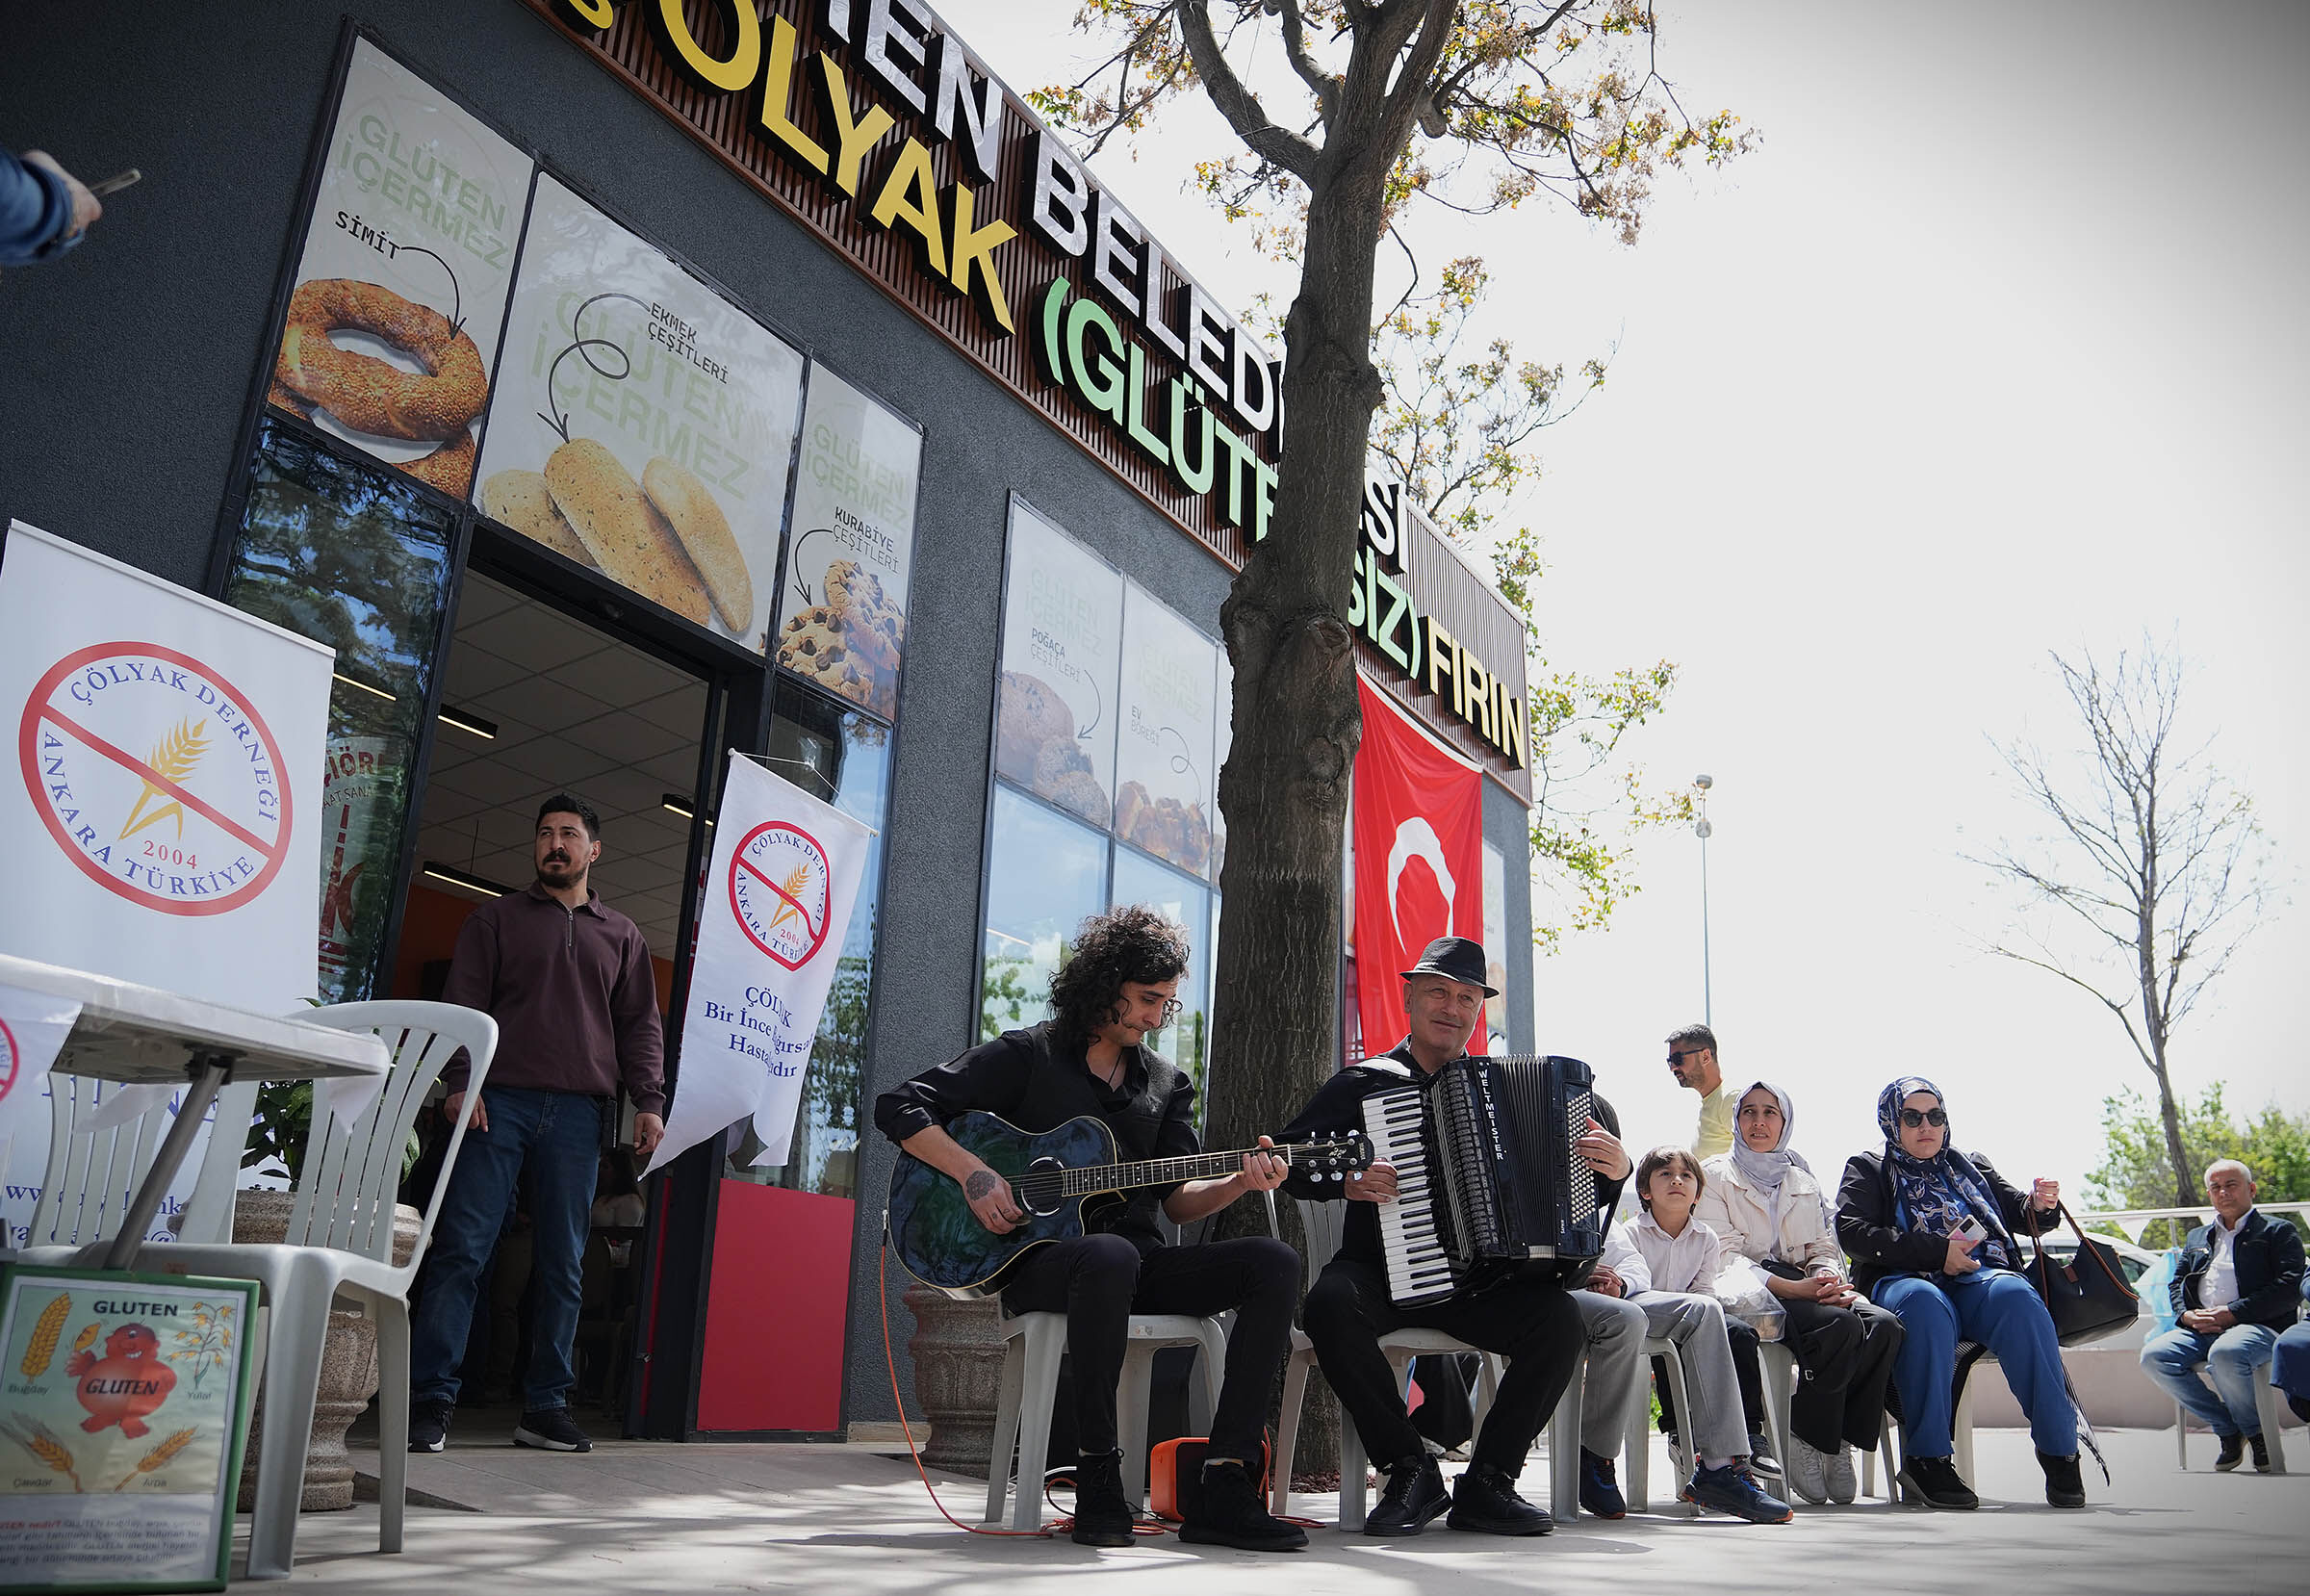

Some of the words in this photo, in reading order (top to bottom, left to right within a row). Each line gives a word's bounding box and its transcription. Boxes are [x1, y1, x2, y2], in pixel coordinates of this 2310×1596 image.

[829, 0, 1003, 183] EN
[359, 115, 506, 232] GLÜTEN
[340, 134, 509, 270] İÇERMEZ
[335, 211, 400, 260] SİMİT
[650, 302, 698, 345] EKMEK
[648, 322, 730, 384] ÇEŞİTLERİ
[834, 506, 894, 553] KURABİYE
[834, 524, 899, 575] ÇEŞİTLERİ
[1032, 627, 1065, 660] POĞAÇA
[1427, 613, 1526, 770] FIRIN
[70, 662, 188, 707] ÇÖLYAK
[195, 684, 279, 822] DERNEĞİ
[44, 732, 114, 865] ANKARA
[124, 856, 255, 896] TÜRKİYE
[143, 839, 198, 870] 2004
[752, 833, 801, 857] ÇÖLYAK
[737, 871, 767, 941] ANKARA
[705, 1000, 734, 1023] Bir
[739, 1007, 772, 1037] İnce
[1478, 1068, 1503, 1161] WELTMEISTER
[93, 1300, 178, 1317] GLUTEN
[86, 1378, 160, 1395] GLUTEN
